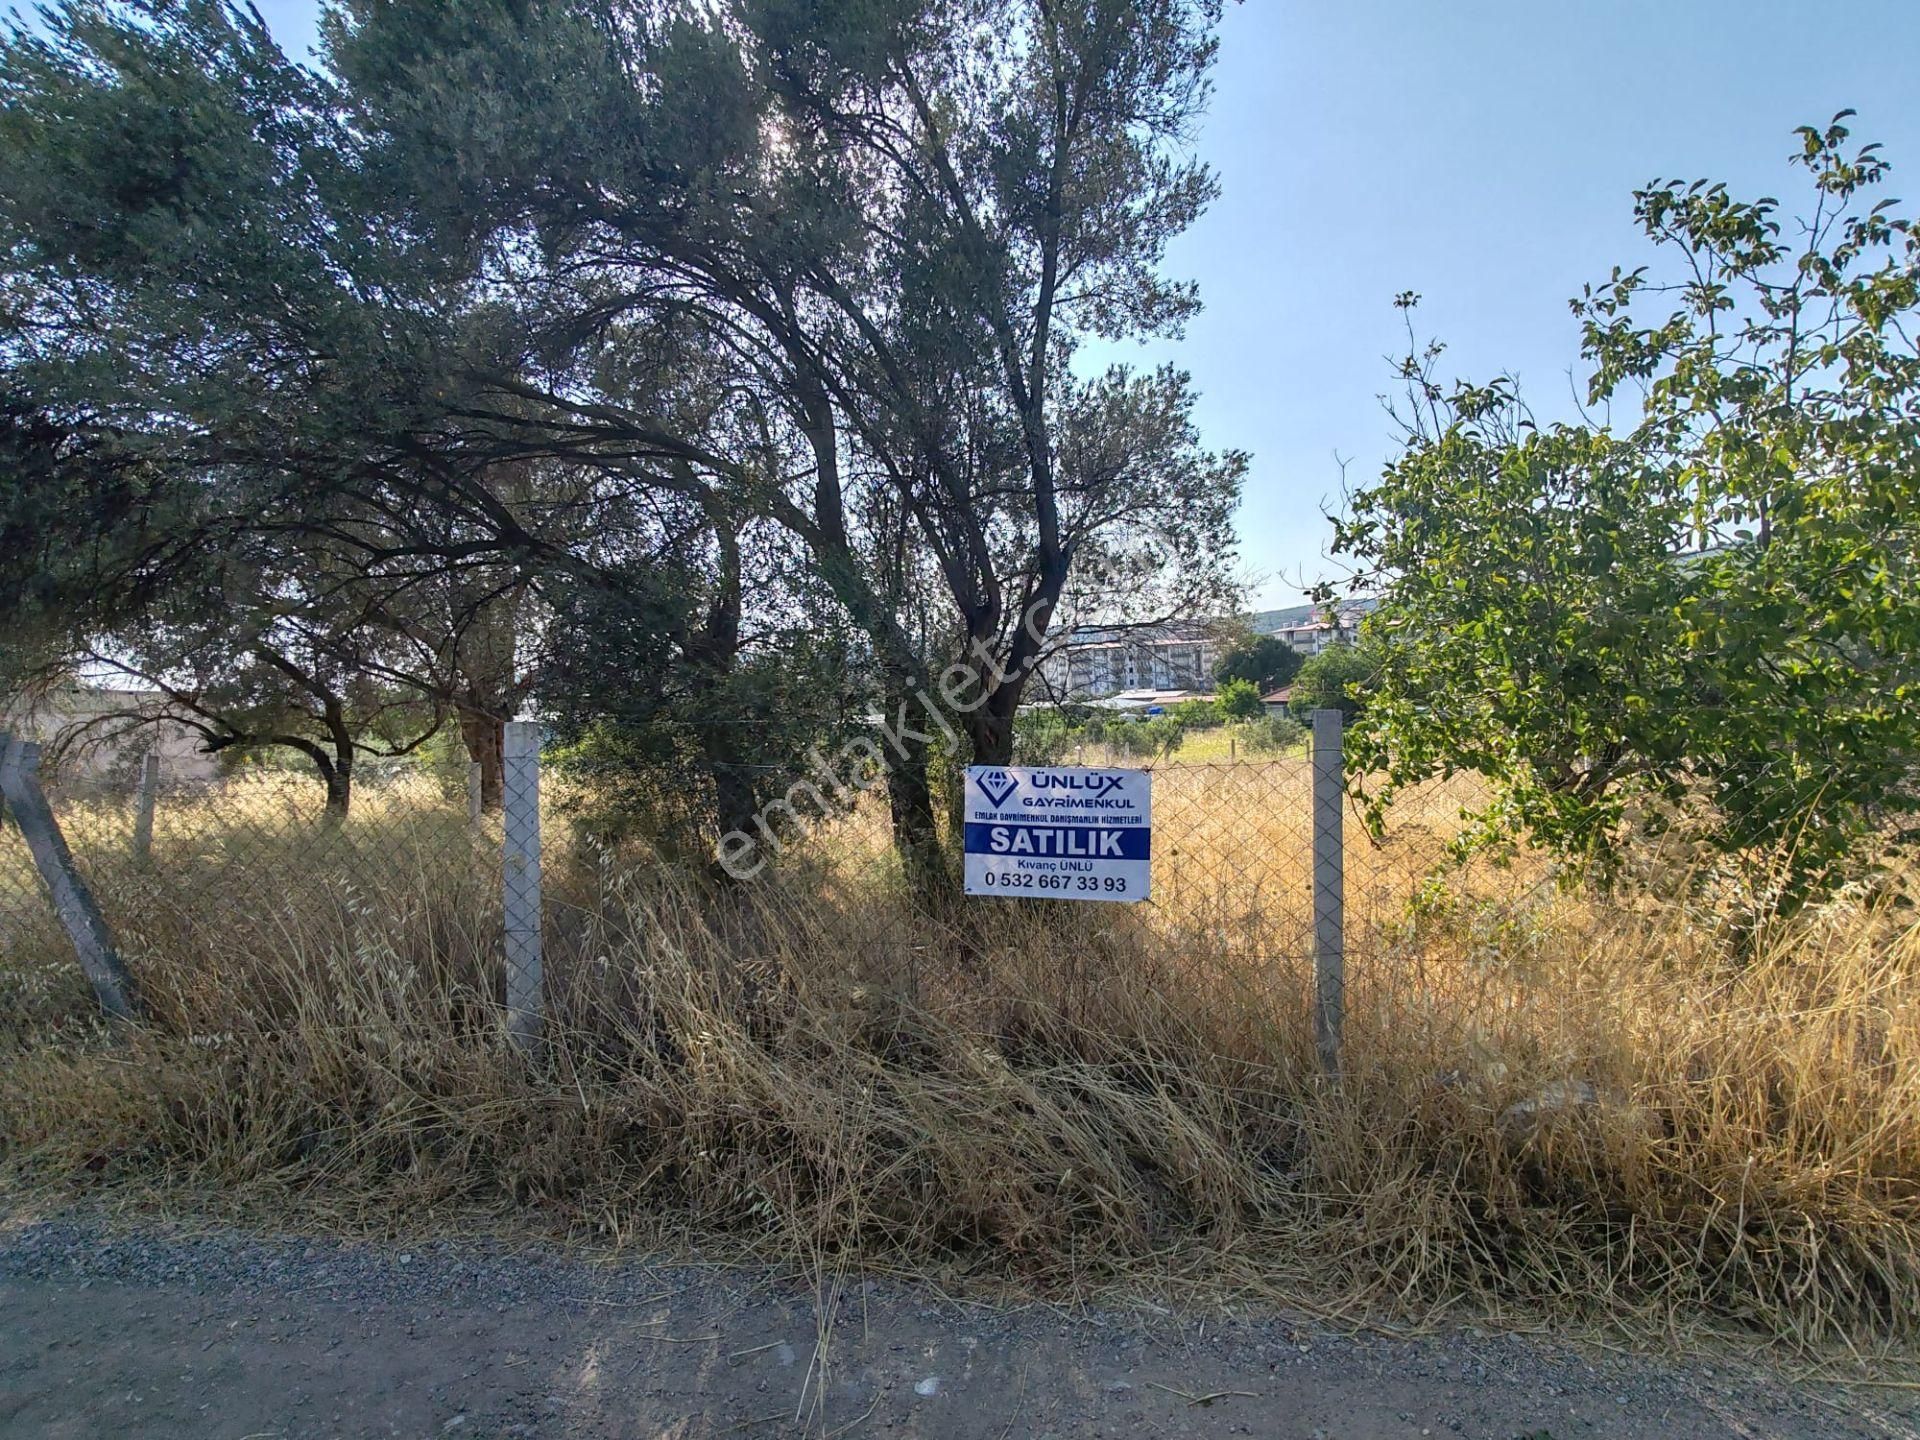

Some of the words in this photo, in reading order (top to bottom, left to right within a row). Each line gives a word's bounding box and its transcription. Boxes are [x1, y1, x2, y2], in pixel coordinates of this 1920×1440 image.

[1031, 771, 1124, 797] ÜNLÜX
[1023, 795, 1135, 808] GAYRİMENKUL
[975, 812, 998, 820] EMLAK
[1000, 812, 1049, 823] GAYRİMENKUL
[1050, 814, 1099, 824] DANIŞMANLIK
[1102, 815, 1142, 824] HİZMETLERİ
[990, 827, 1123, 856] SATILIK
[1018, 860, 1056, 871] Kıvanç
[1060, 861, 1093, 871] ÜNLÜ
[985, 872, 995, 886] 0
[1001, 873, 1033, 887] 532
[1038, 875, 1071, 889] 667
[1077, 877, 1098, 891] 33
[1104, 878, 1126, 892] 93
